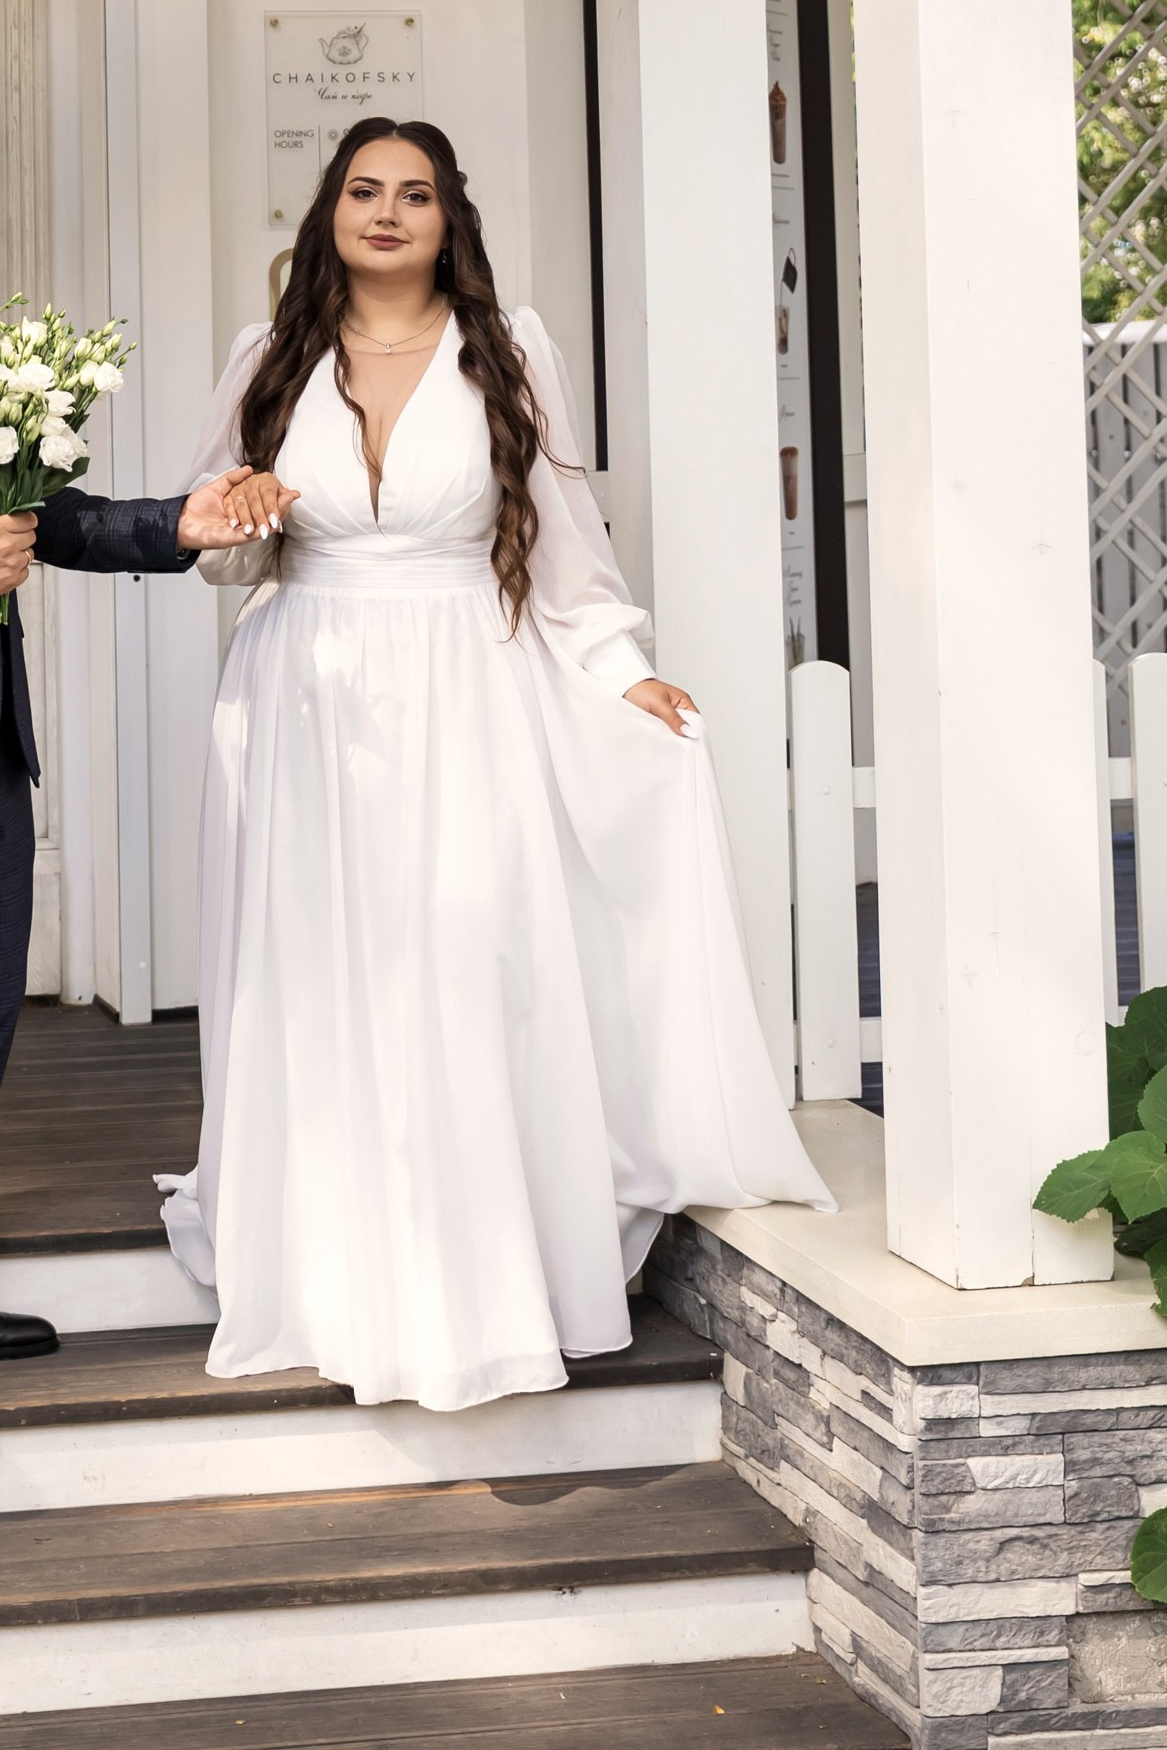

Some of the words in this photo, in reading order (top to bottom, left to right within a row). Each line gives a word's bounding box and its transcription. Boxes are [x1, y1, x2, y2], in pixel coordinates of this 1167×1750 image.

[272, 72, 416, 84] CHAIKOFSKY
[273, 129, 315, 138] OPENING
[274, 140, 304, 149] HOURS
